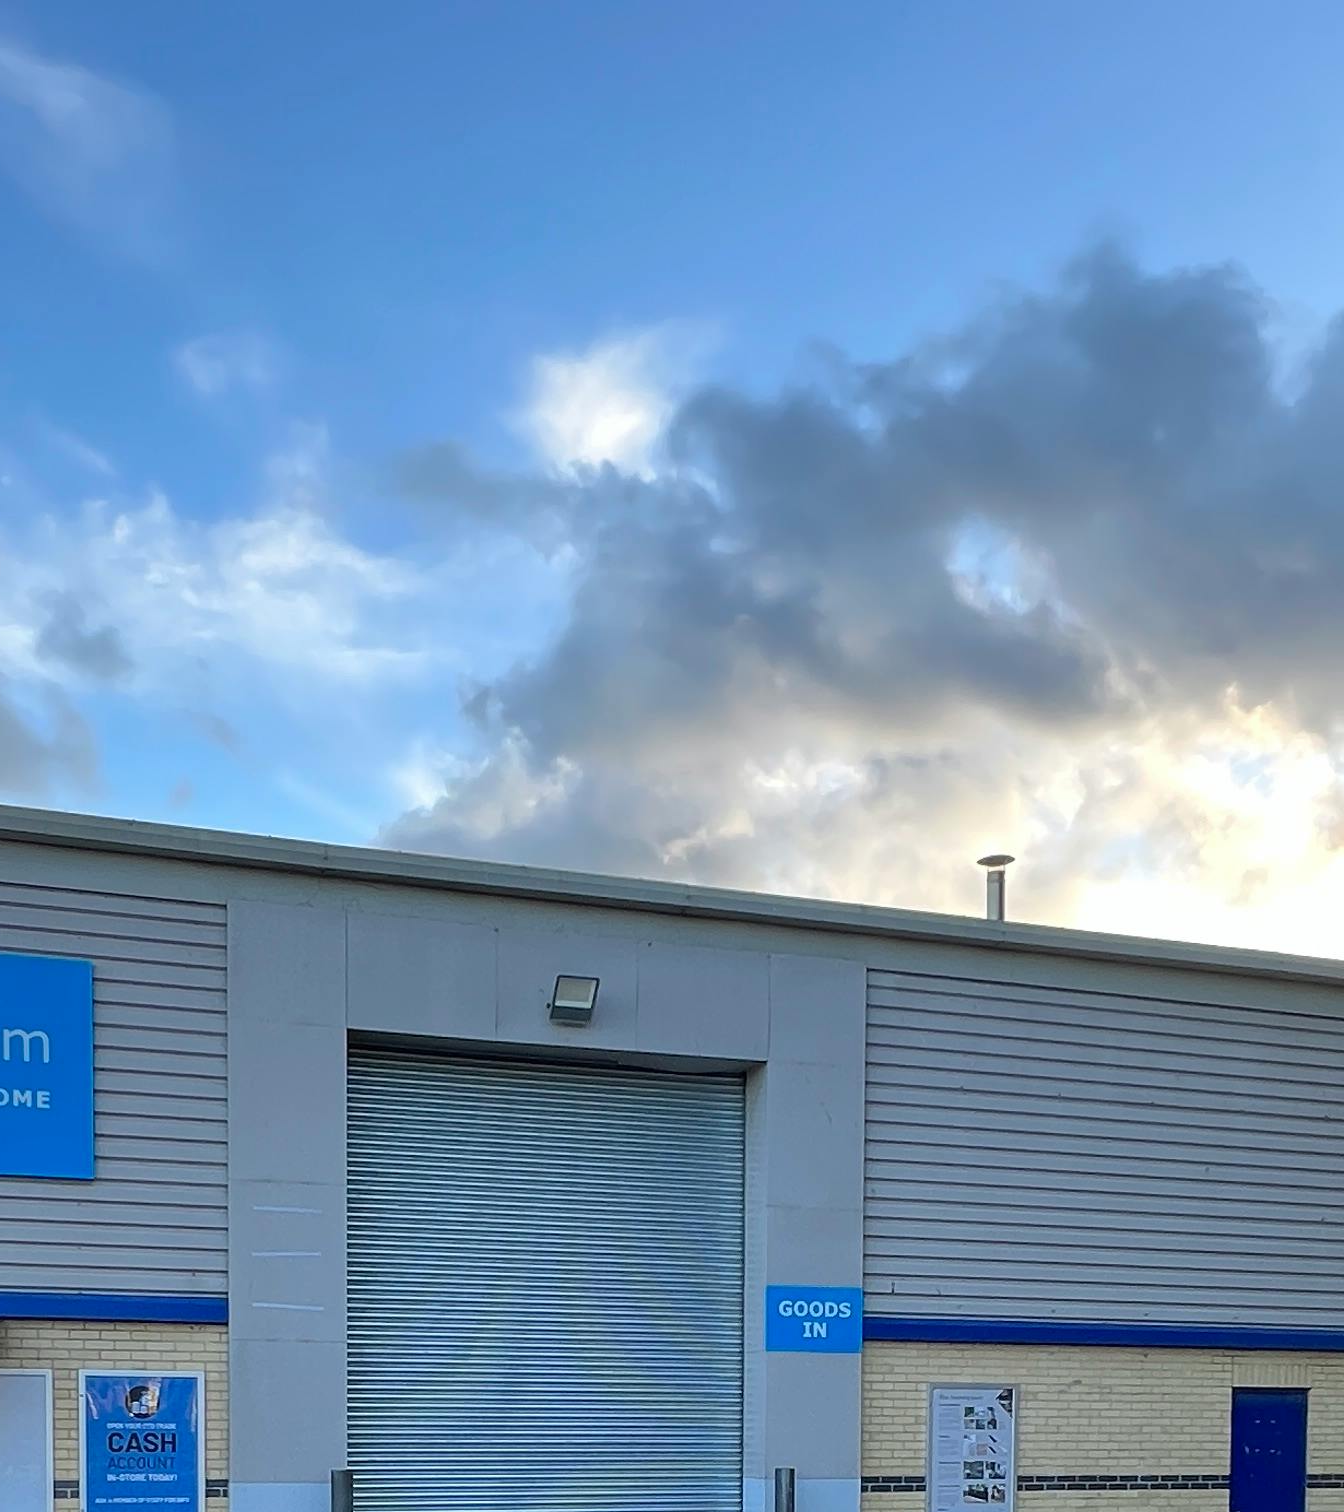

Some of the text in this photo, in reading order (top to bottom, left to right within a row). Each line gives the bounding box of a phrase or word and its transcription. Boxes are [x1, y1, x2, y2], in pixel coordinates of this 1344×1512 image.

[778, 1300, 852, 1318] GOODS
[802, 1321, 827, 1338] IN
[107, 1432, 177, 1453] CASH
[108, 1457, 176, 1469] ACCOUNT
[107, 1473, 147, 1482] IN-STORE
